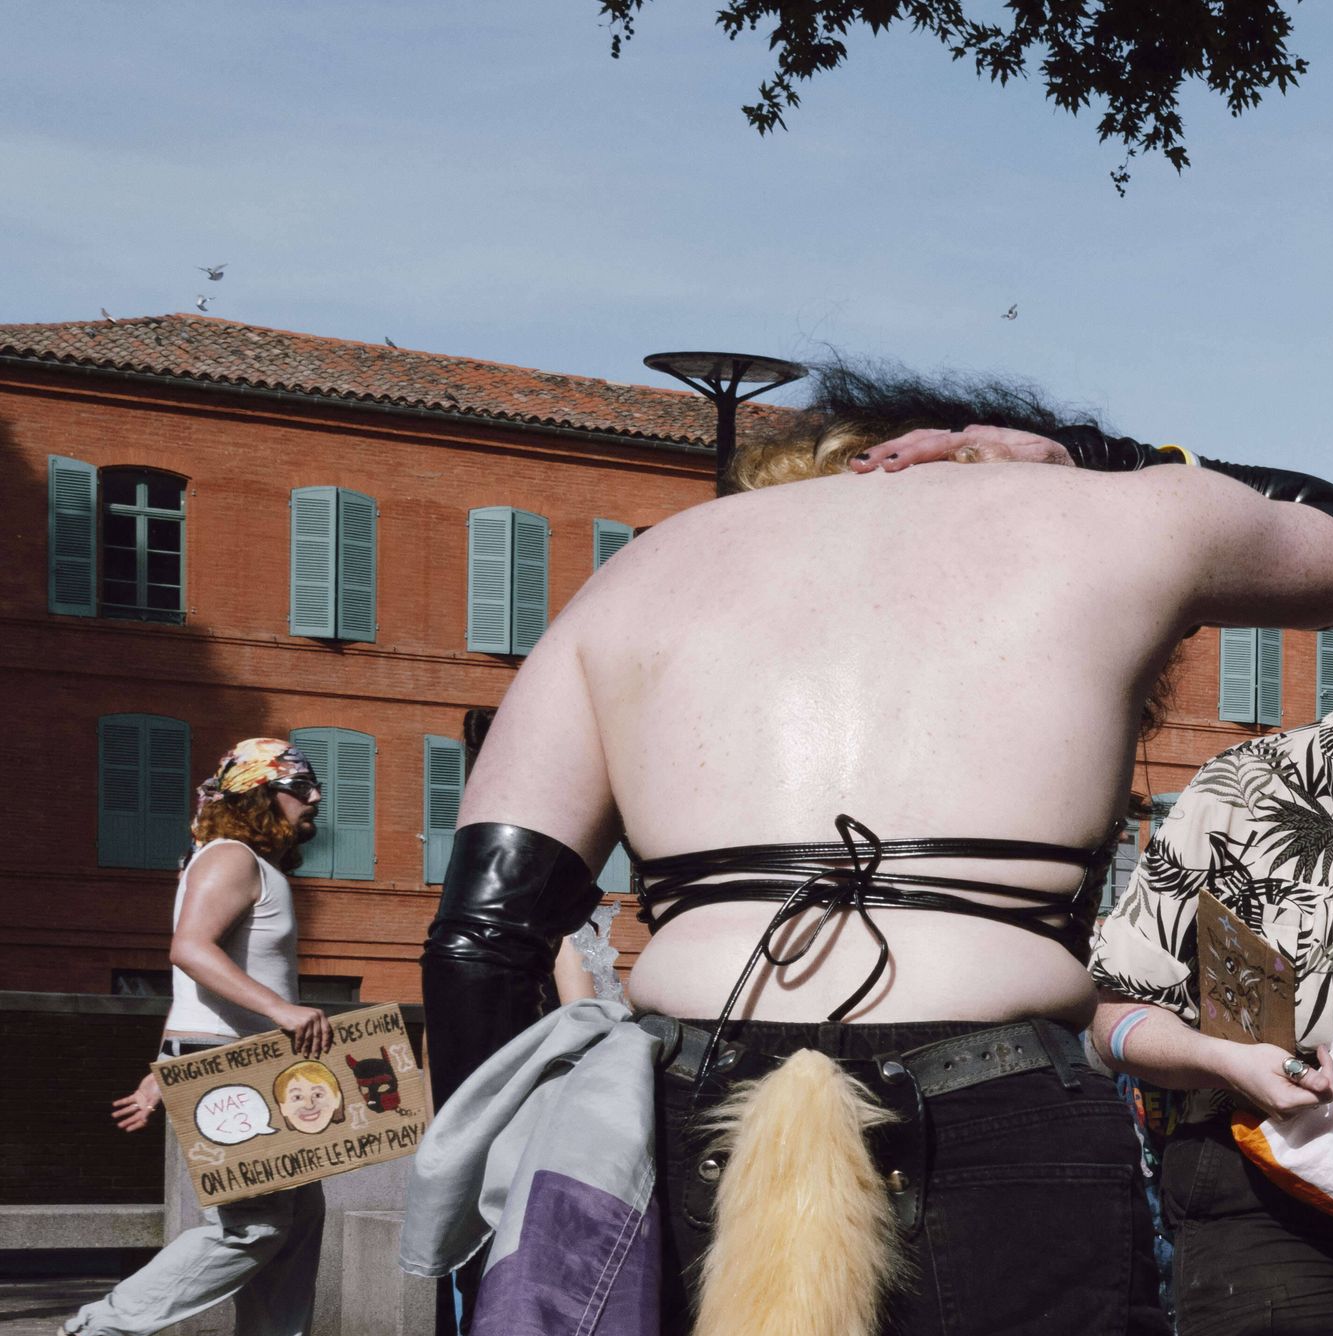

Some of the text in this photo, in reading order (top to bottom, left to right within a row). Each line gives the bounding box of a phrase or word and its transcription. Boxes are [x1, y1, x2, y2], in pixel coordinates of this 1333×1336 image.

[338, 1022, 364, 1044] DES
[201, 1169, 227, 1195] ON
[226, 1166, 242, 1191] A
[275, 1147, 325, 1178] CONTRE
[325, 1143, 345, 1166] LE
[344, 1132, 382, 1161] PUPPY
